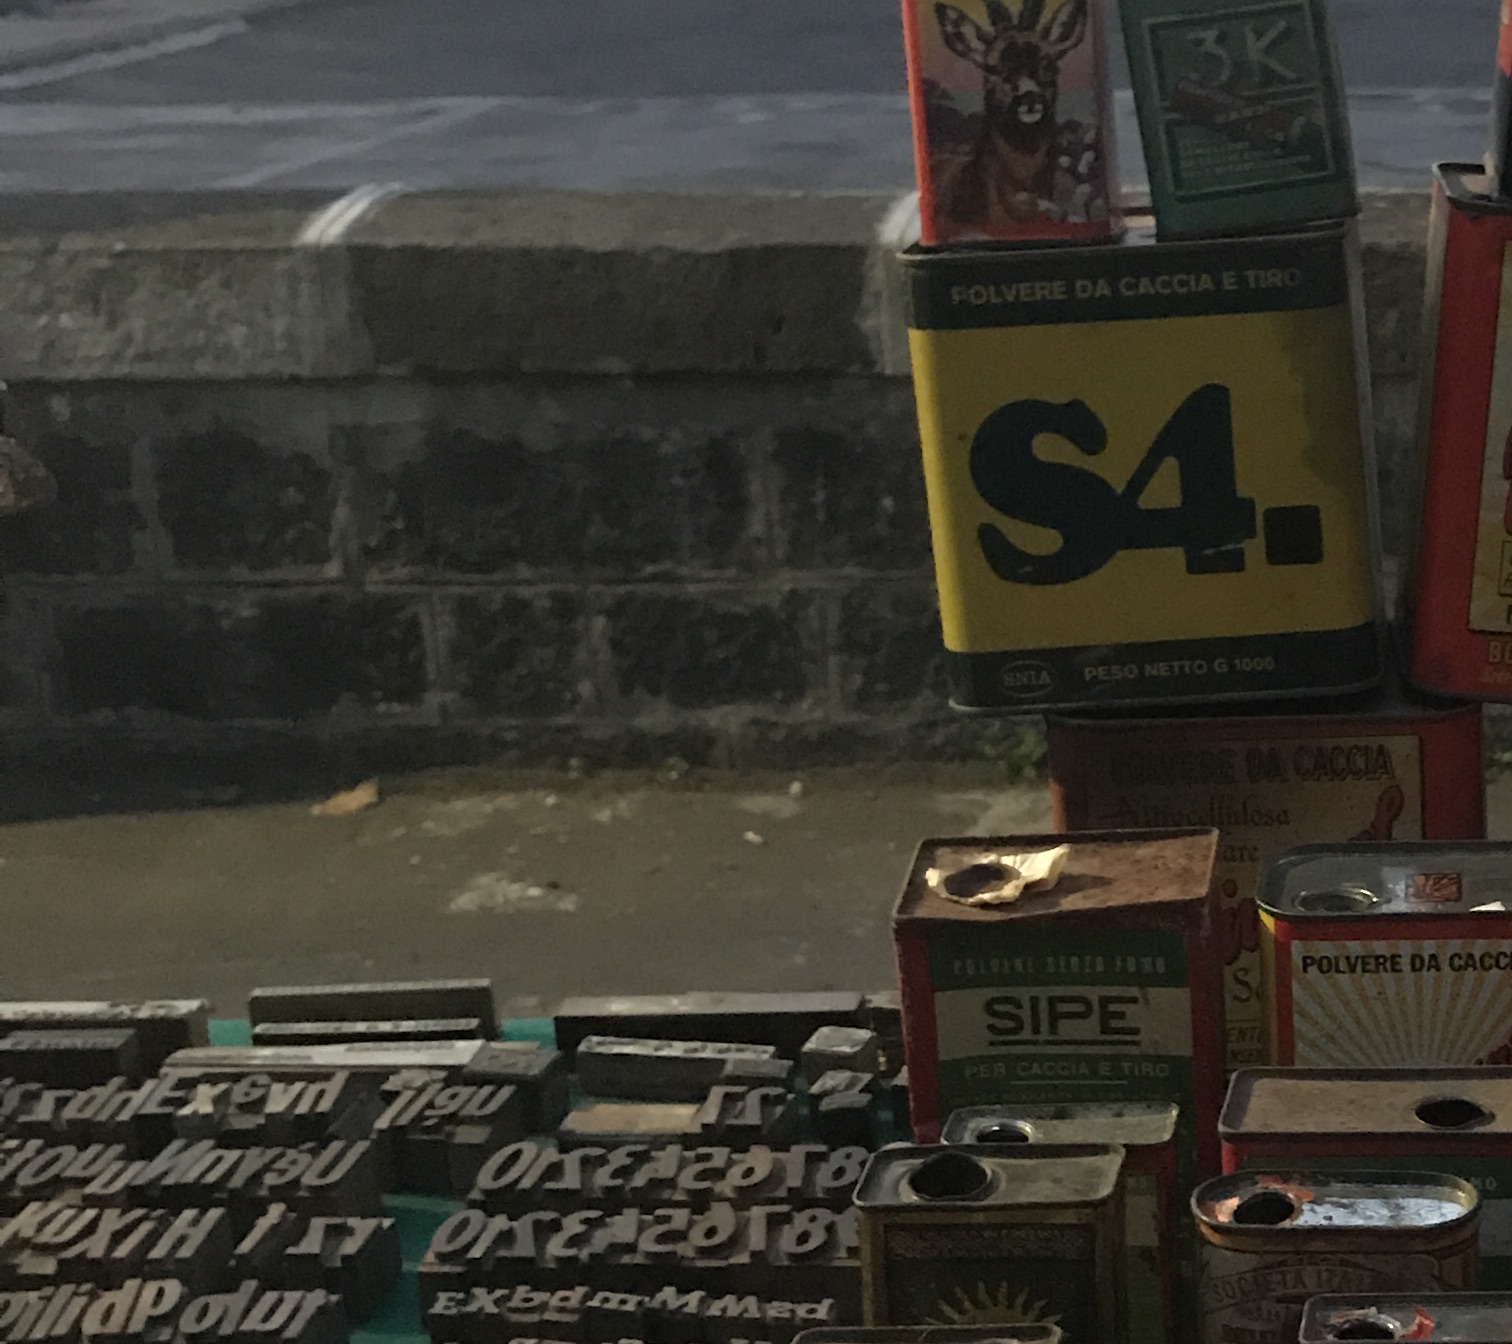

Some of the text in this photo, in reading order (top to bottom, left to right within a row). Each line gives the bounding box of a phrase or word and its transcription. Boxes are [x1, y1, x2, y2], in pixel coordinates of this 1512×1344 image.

[951, 269, 1300, 306] POLVERE DA CACCIA E TIRO
[1084, 661, 1138, 681] PESO
[1143, 659, 1208, 677] NETTO
[1213, 658, 1229, 674] G
[1233, 657, 1275, 673] 1000
[1246, 747, 1289, 783] DA
[1294, 744, 1396, 781] CACCIA
[1301, 954, 1403, 974] POLVERE
[1411, 953, 1442, 973] DA
[984, 995, 1142, 1036] SIPE
[965, 1062, 1170, 1078] PER CACCIA E TIRO
